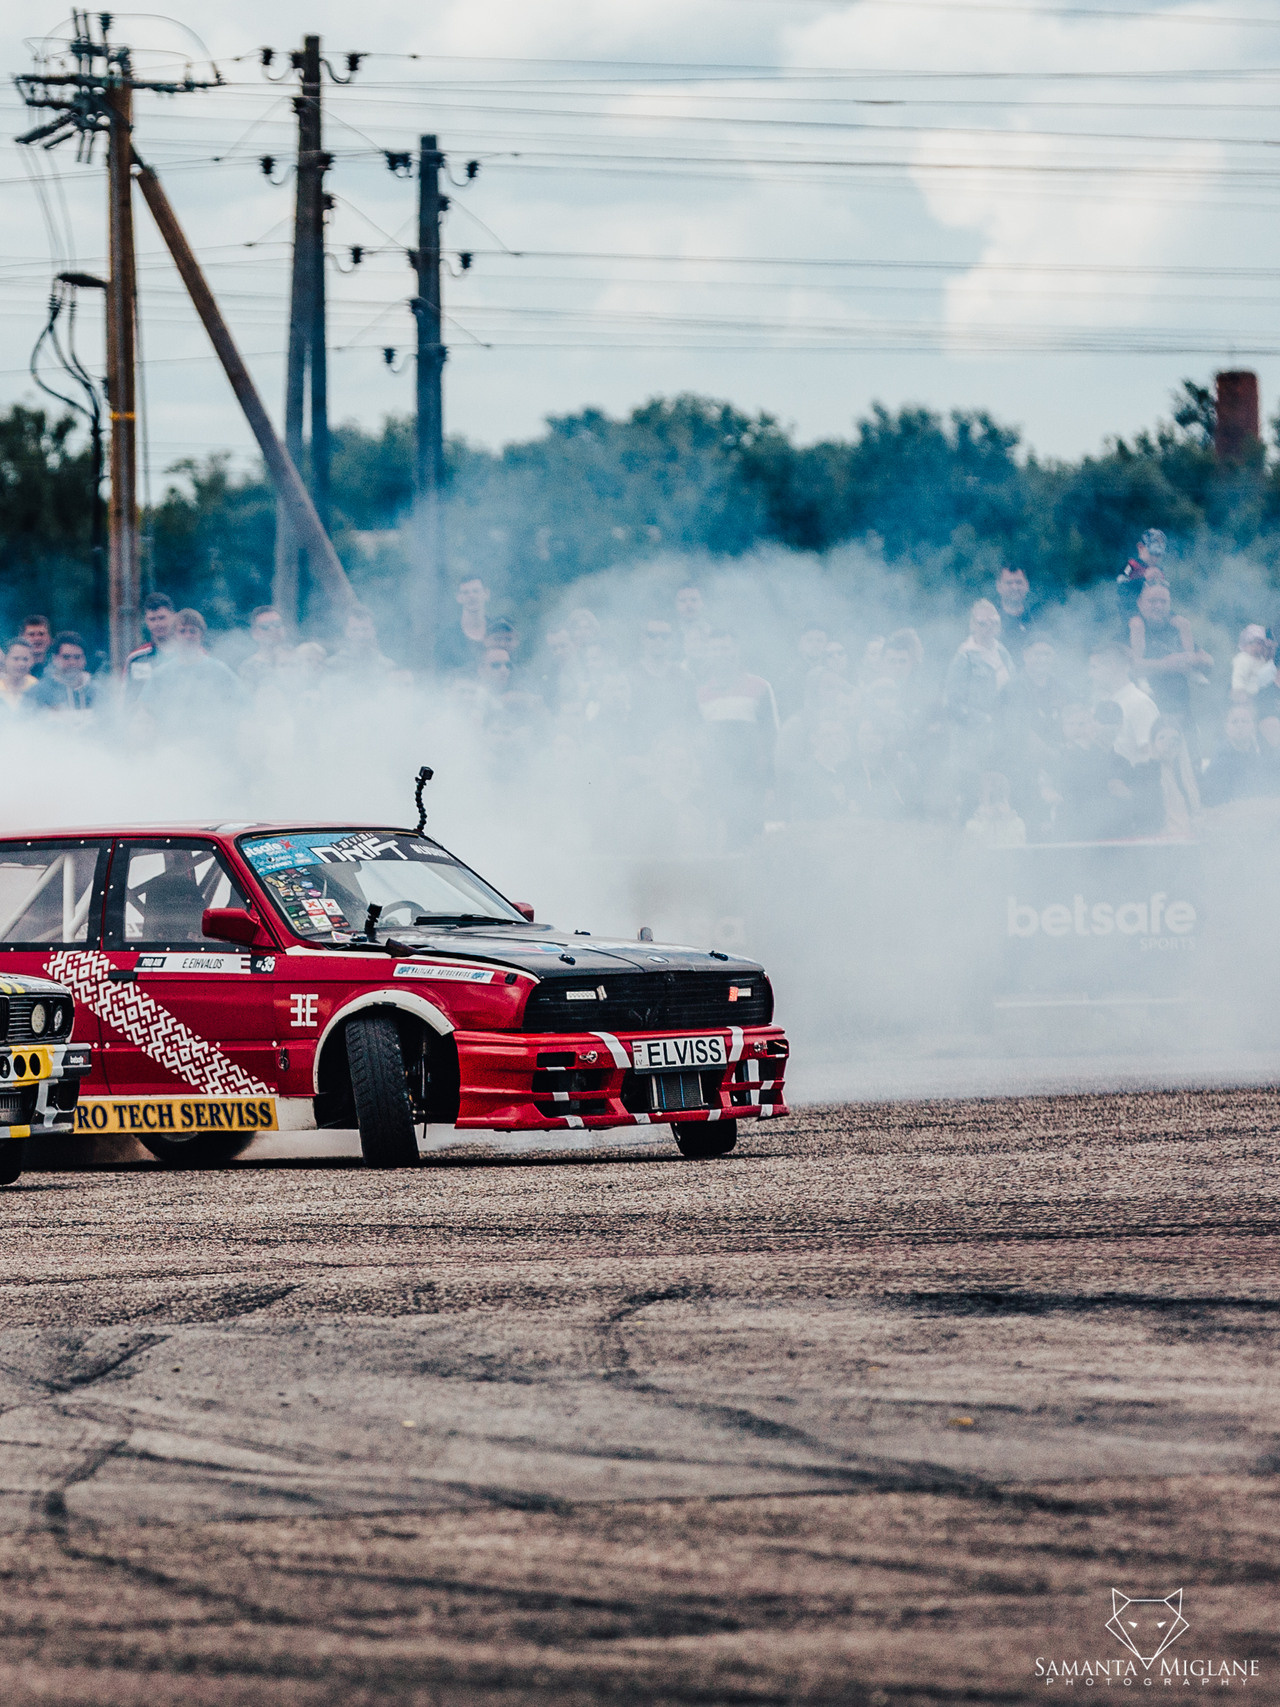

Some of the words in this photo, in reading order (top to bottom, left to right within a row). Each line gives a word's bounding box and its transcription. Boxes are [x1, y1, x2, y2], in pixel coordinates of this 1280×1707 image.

[310, 837, 408, 863] DRIFT
[1007, 891, 1197, 937] betsafe
[1139, 937, 1197, 950] SPORTS
[647, 1038, 722, 1067] ELVISS
[113, 1103, 175, 1129] TECH
[181, 1102, 273, 1128] SERVISS
